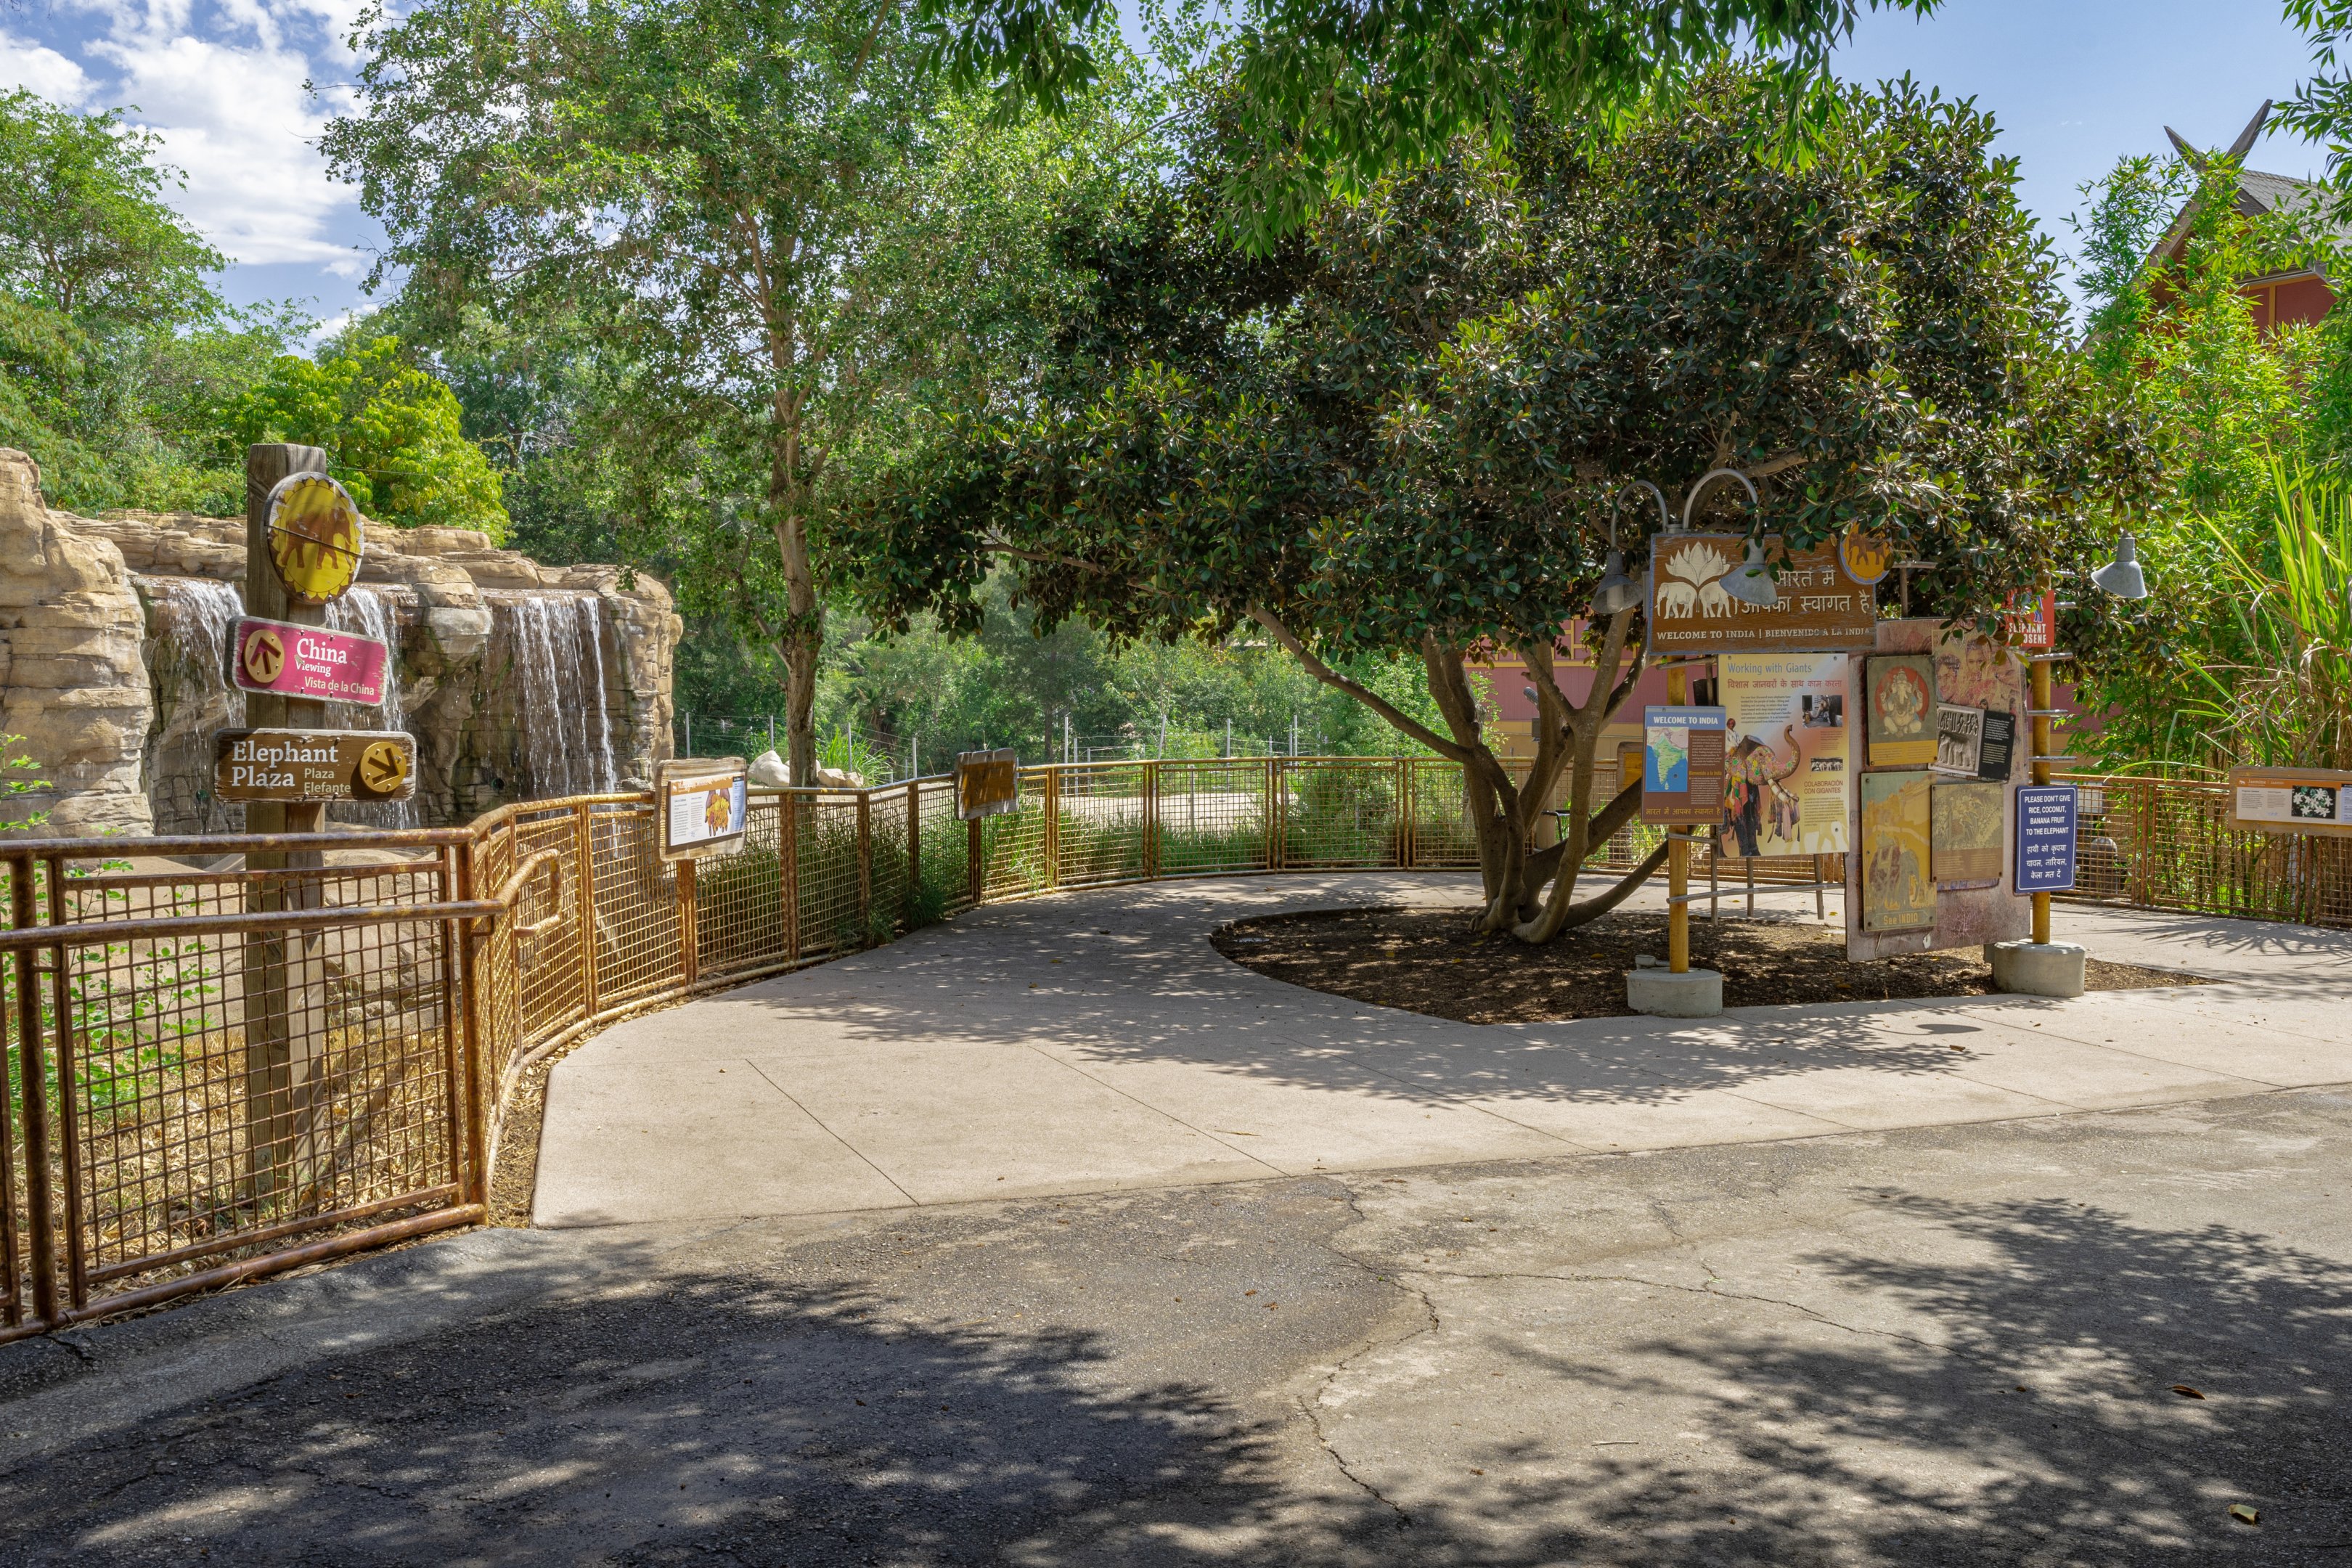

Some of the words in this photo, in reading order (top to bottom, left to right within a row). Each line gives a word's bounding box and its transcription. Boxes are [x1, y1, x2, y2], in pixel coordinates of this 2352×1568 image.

[1822, 565, 1836, 586] में
[1800, 595, 1851, 611] स्वागत
[1859, 589, 1870, 613] है
[1657, 631, 1707, 640] WELCOME
[1710, 630, 1723, 639] TO
[1726, 629, 1755, 638] INDIA
[2009, 633, 2046, 644] OSENE
[297, 638, 347, 663] China
[295, 661, 331, 677] Viewing
[1728, 663, 1762, 675] Working
[1765, 663, 1782, 673] with
[1786, 663, 1812, 673] Giants
[305, 677, 325, 690] Vista
[328, 679, 339, 691] de
[341, 681, 348, 693] la
[351, 682, 375, 695] China
[1727, 679, 1749, 689] विशाल
[1752, 678, 1777, 689] जानवरों
[1780, 678, 1787, 688] के
[1654, 716, 1686, 724] WELCOME
[232, 740, 339, 768] Elephant
[232, 766, 295, 787] Plaza
[304, 768, 335, 779] Plaza
[303, 782, 351, 793] Elefante
[1804, 779, 1843, 788] COLABORACIÓN
[1716, 807, 1720, 815] है
[2027, 844, 2039, 854] हाथी
[2041, 844, 2049, 852] को
[2051, 844, 2067, 854] कृपया
[2045, 857, 2067, 865] नारियल,
[2031, 870, 2043, 879] केला
[1883, 915, 1897, 925] See
[1899, 912, 1918, 924] INDIA
